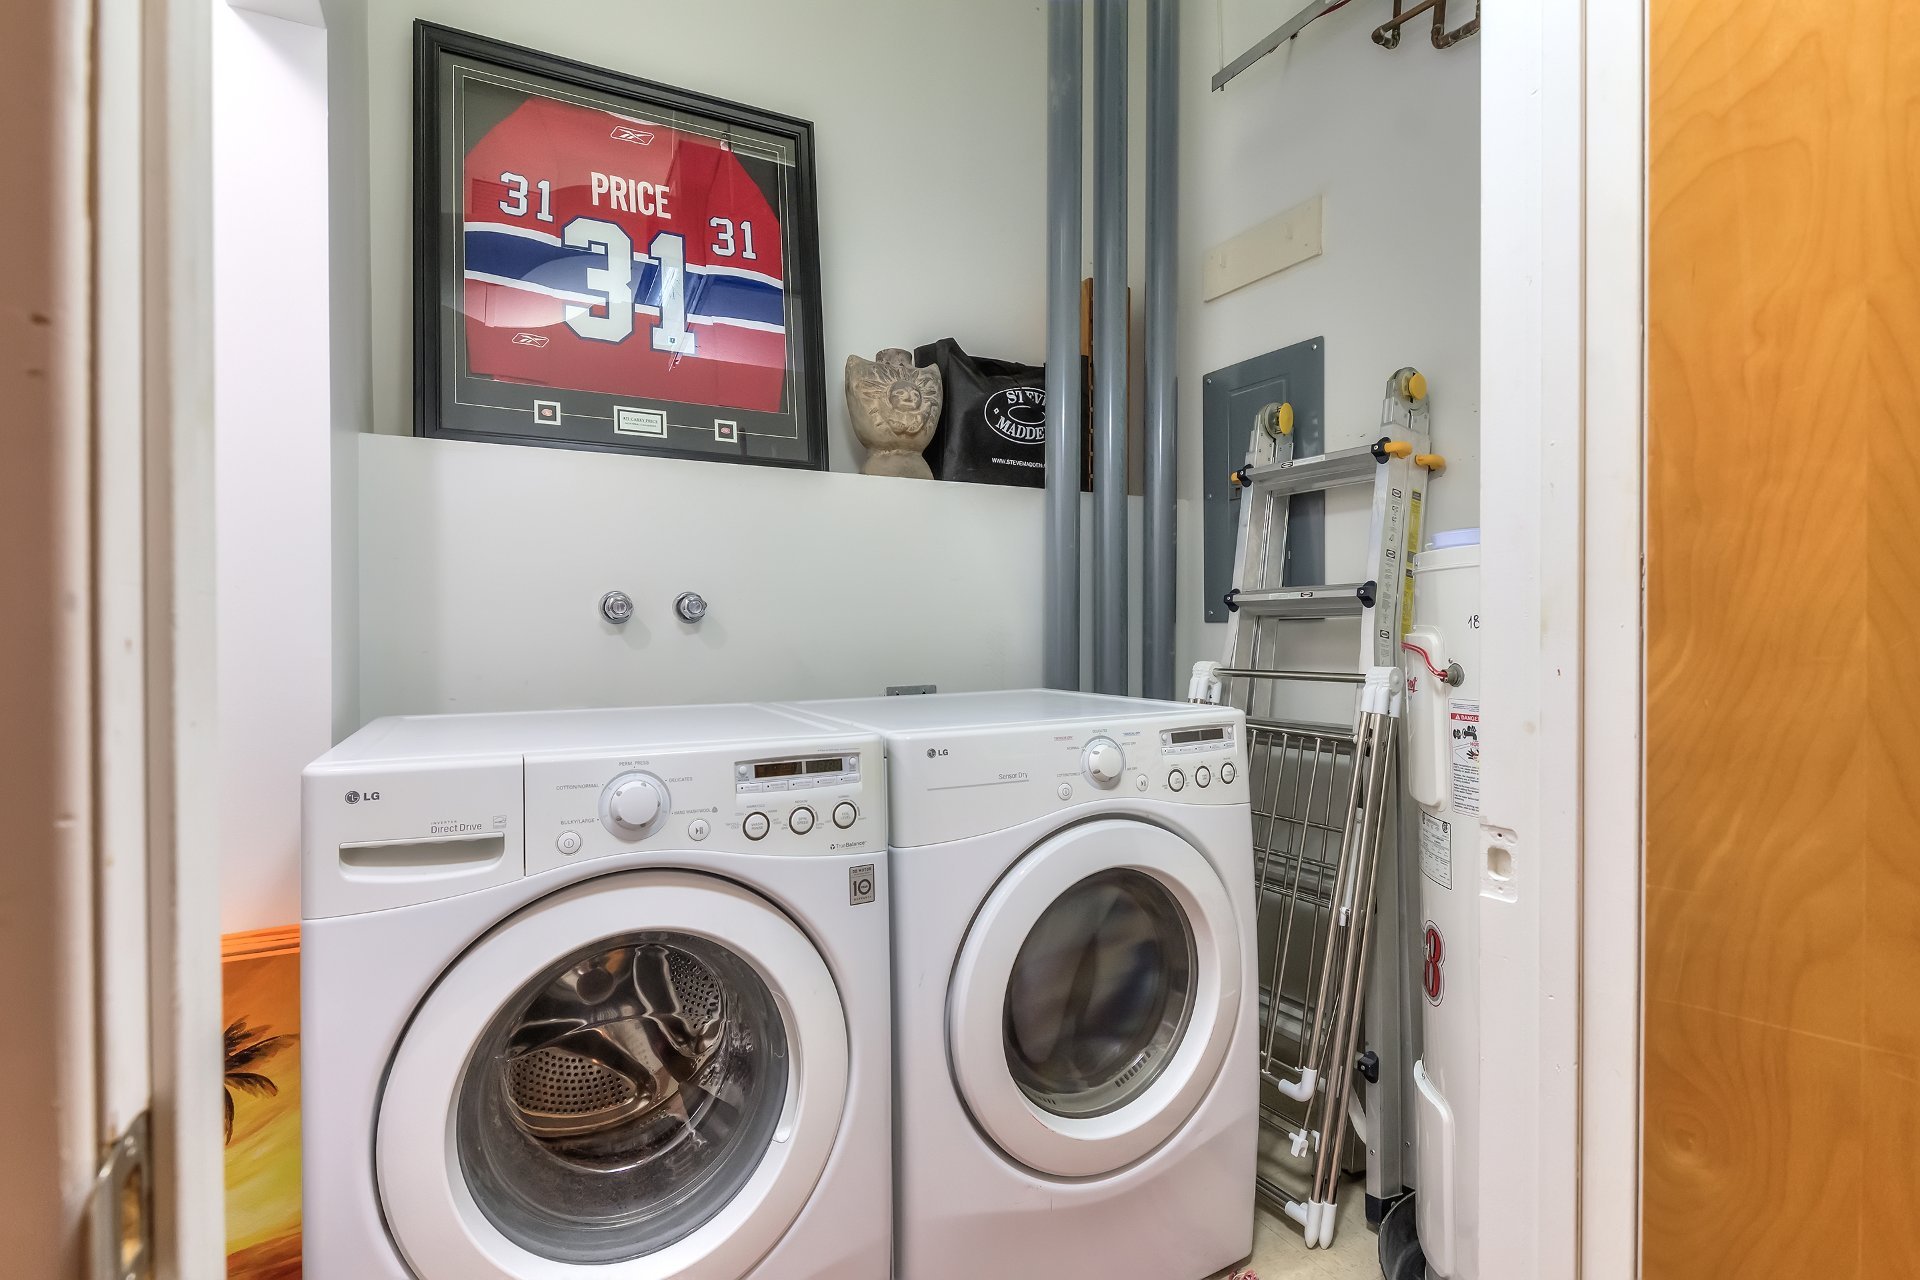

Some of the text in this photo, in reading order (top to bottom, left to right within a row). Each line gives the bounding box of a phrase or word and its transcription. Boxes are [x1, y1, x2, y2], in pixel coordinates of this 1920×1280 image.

[499, 171, 555, 224] 31
[590, 171, 672, 220] PRICE
[709, 216, 757, 260] 31
[561, 214, 697, 356] 31
[996, 416, 1046, 440] MADDE
[1460, 714, 1480, 722] DANGE
[1018, 771, 1028, 779] Dry
[363, 791, 380, 801] LG
[430, 823, 482, 834] Direct Drive
[853, 878, 872, 897] 10
